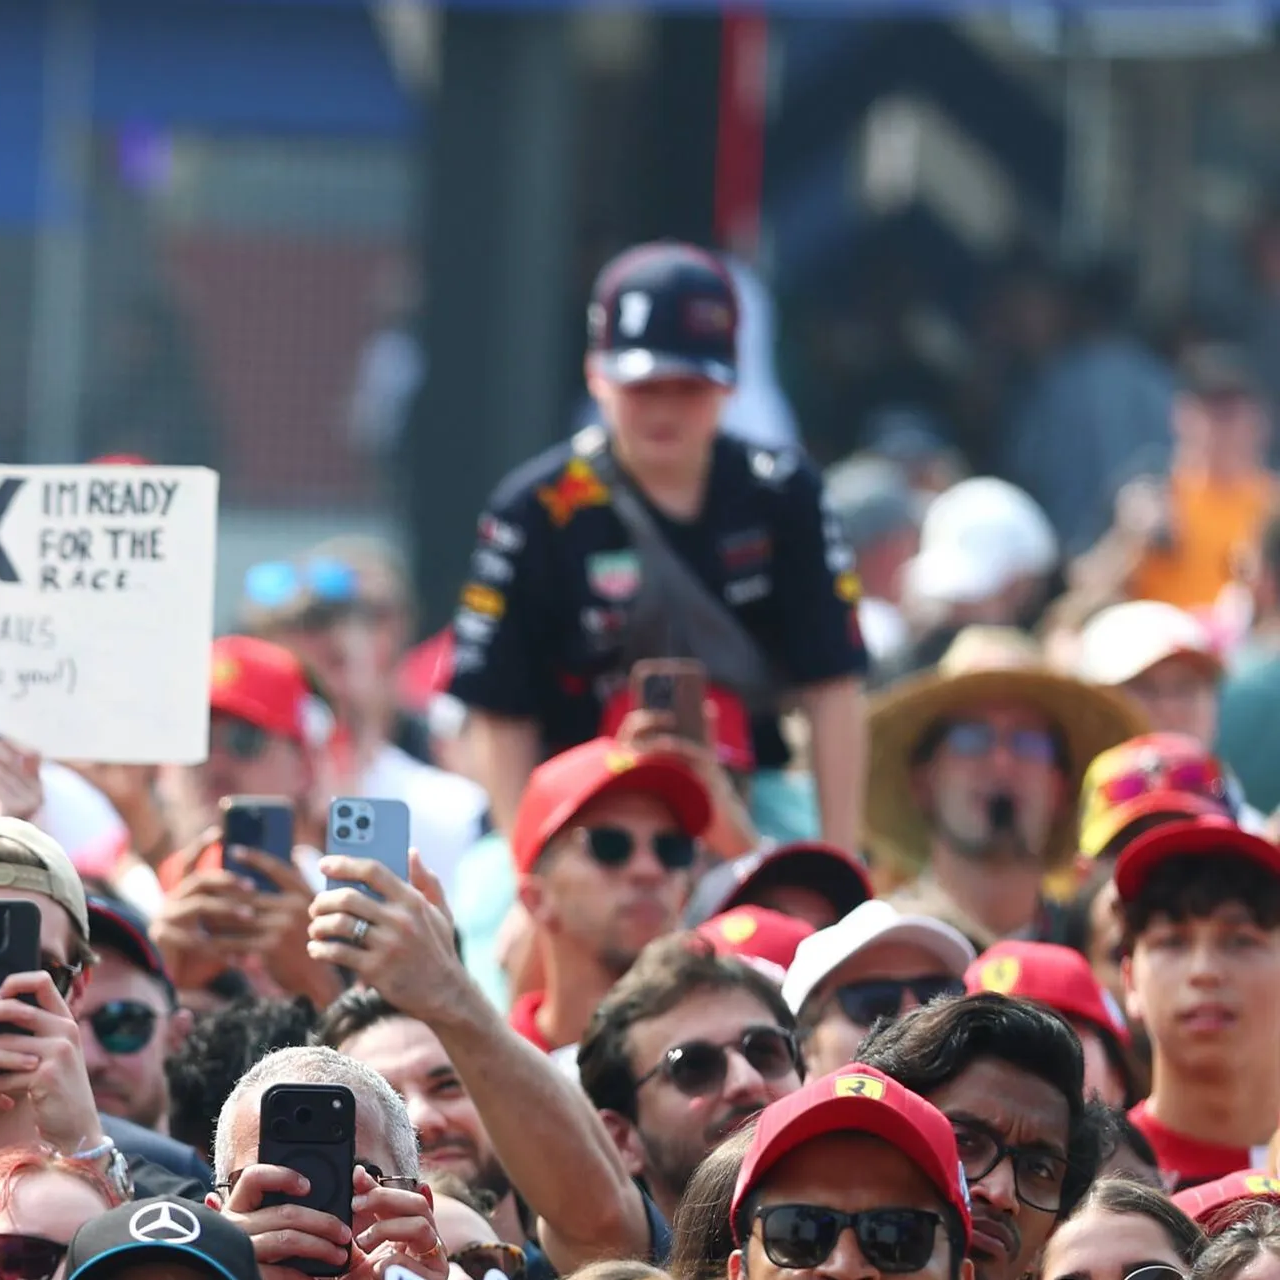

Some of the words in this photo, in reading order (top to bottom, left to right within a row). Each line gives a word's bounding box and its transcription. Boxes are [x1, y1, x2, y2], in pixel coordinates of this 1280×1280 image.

[88, 479, 180, 516] READY
[40, 527, 93, 561] FOR
[103, 526, 165, 560] THE
[40, 565, 129, 592] RACE
